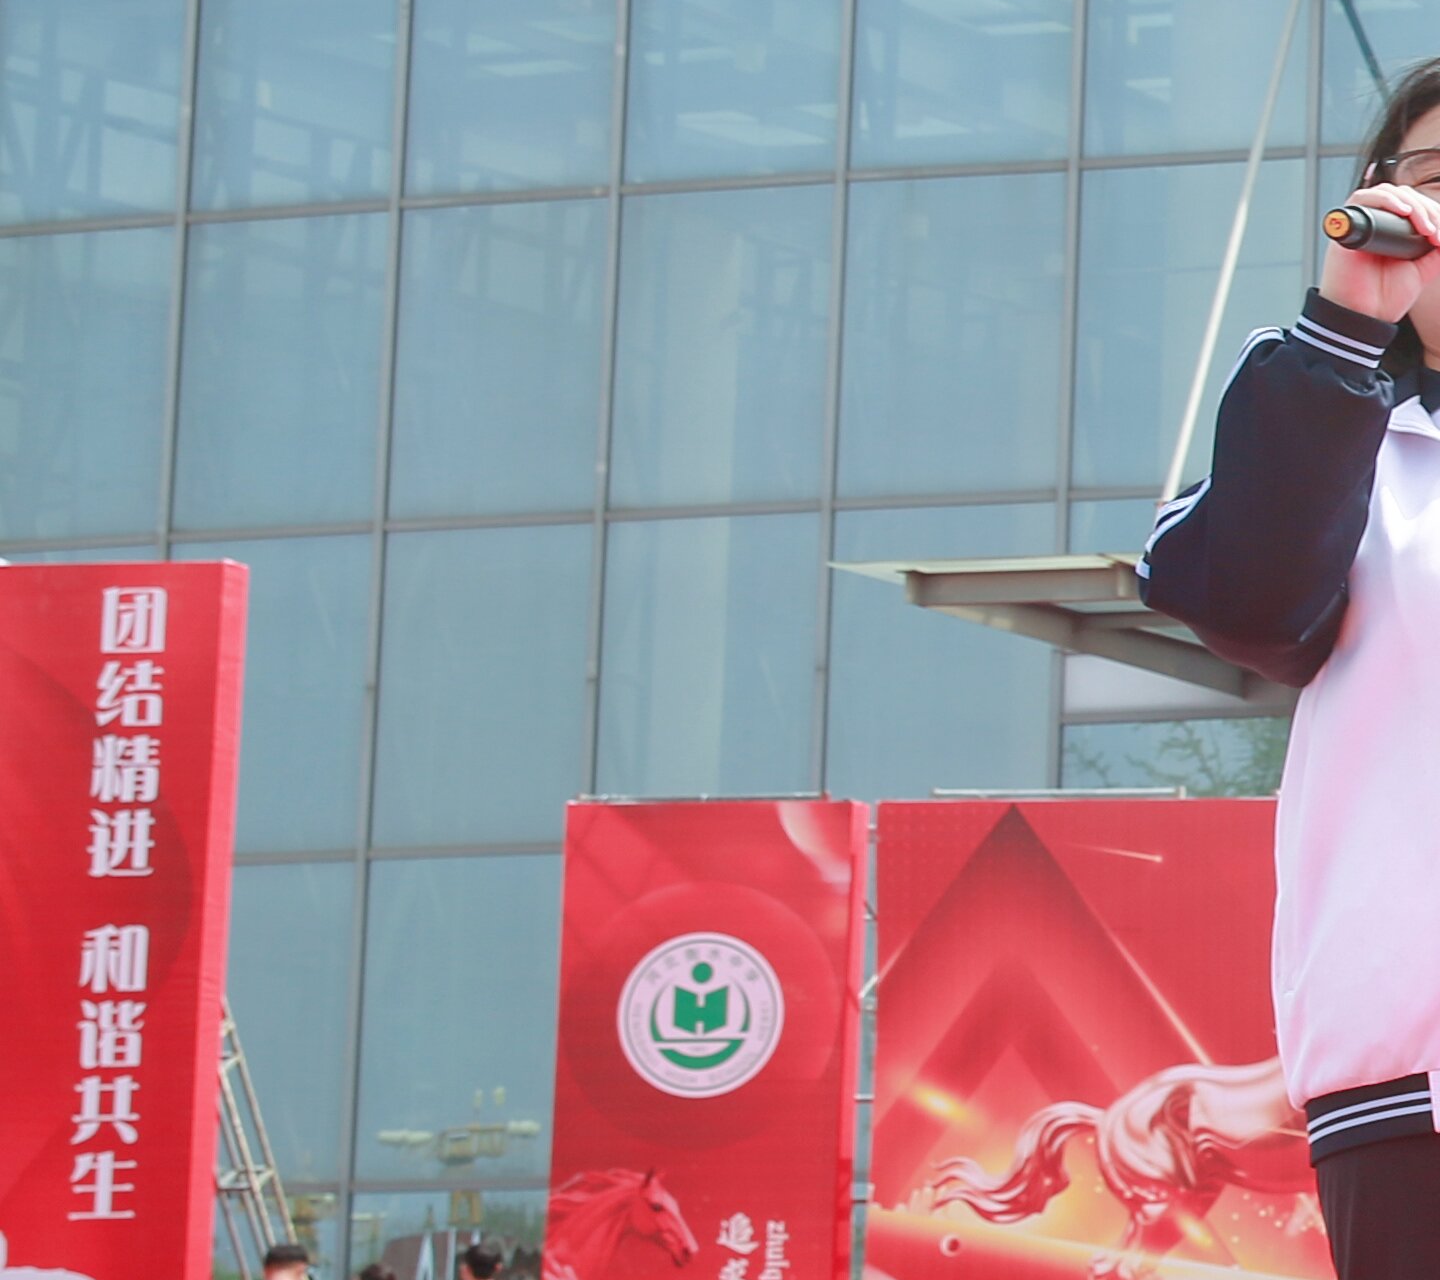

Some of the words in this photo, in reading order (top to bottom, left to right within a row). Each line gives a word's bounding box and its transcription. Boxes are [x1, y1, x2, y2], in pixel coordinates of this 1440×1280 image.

[87, 585, 167, 879] 团结精进
[69, 924, 149, 1222] 和谐共生
